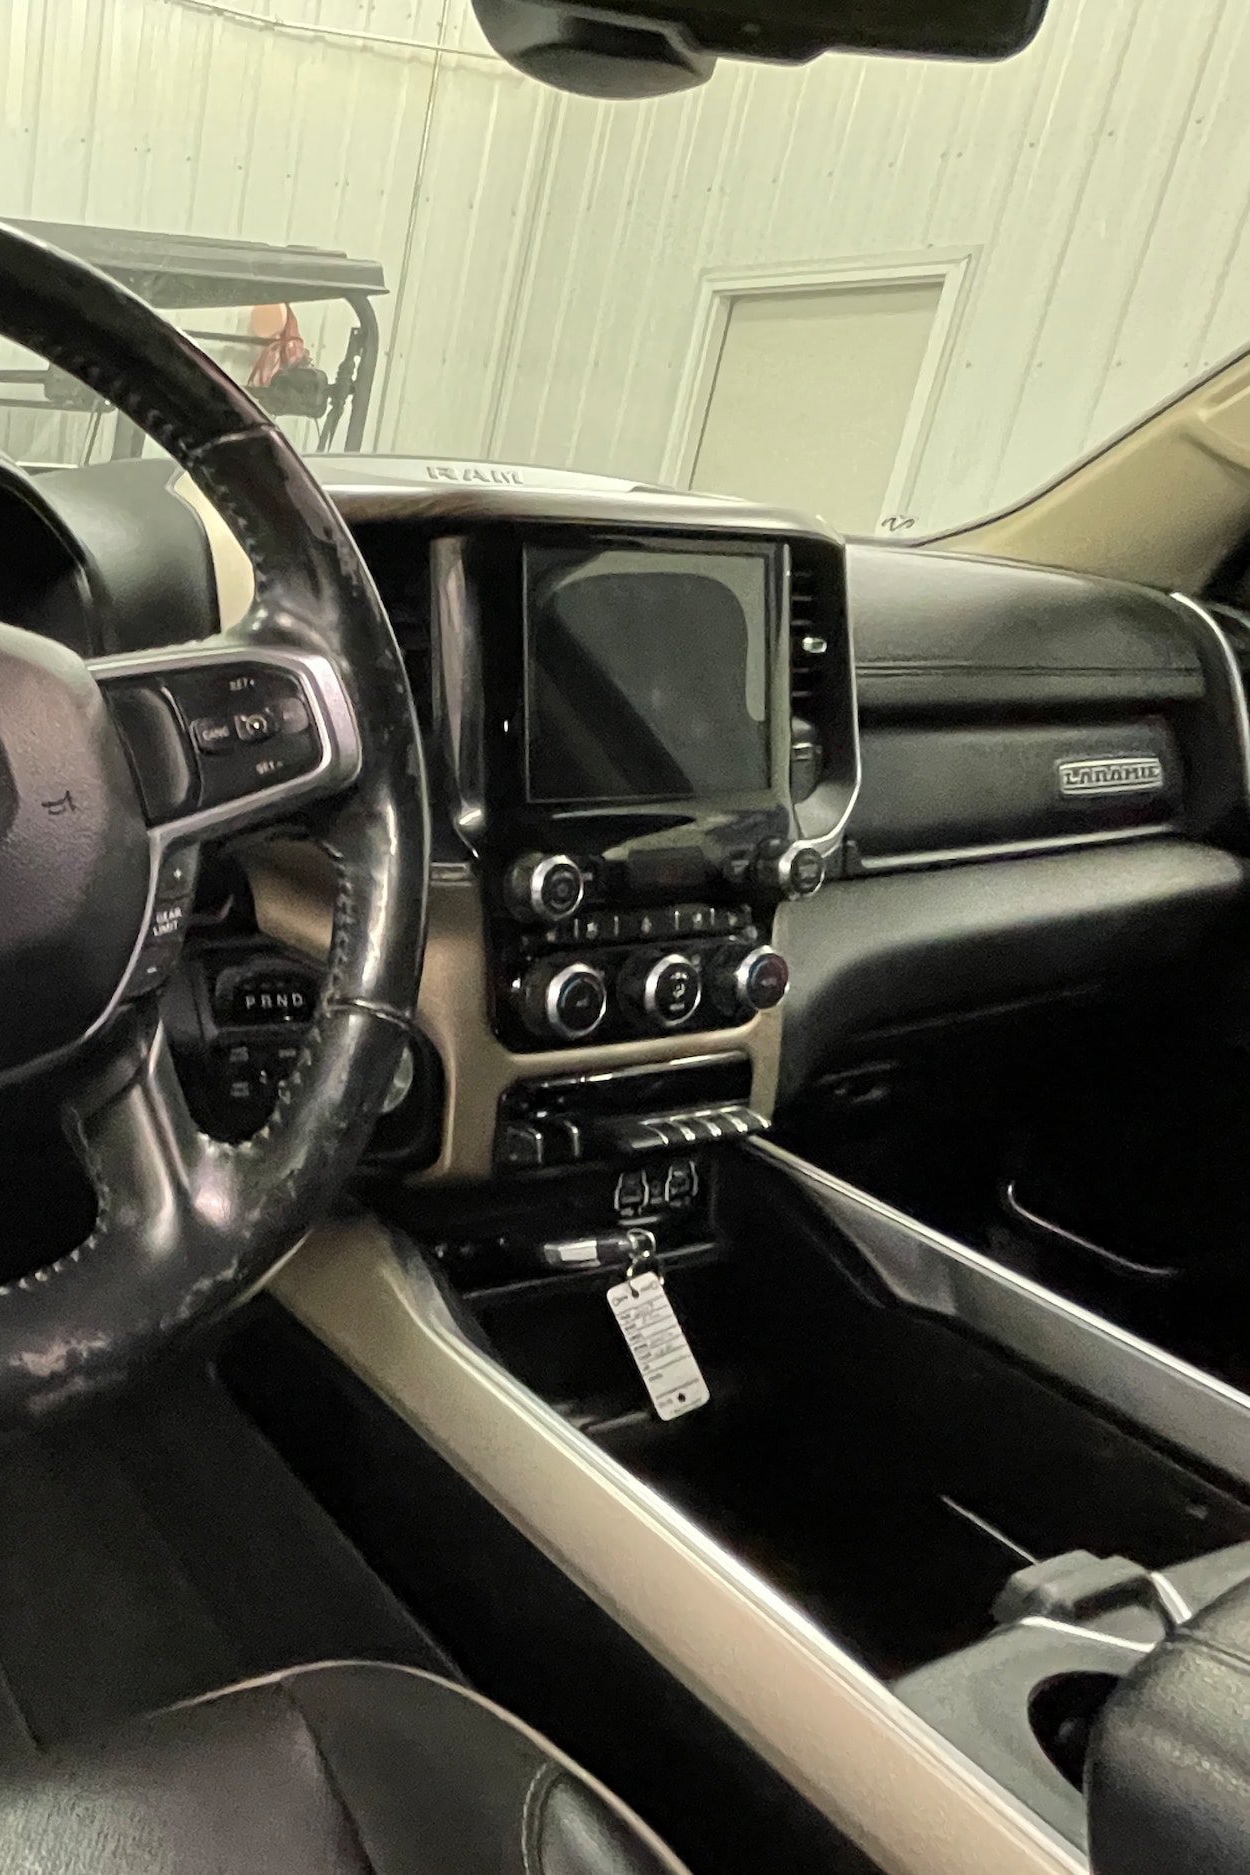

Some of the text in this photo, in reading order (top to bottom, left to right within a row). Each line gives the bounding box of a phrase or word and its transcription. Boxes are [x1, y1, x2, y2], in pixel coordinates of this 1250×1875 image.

[425, 465, 524, 485] RAM
[1061, 765, 1161, 786] LARAMIE
[152, 919, 180, 937] LIMIT
